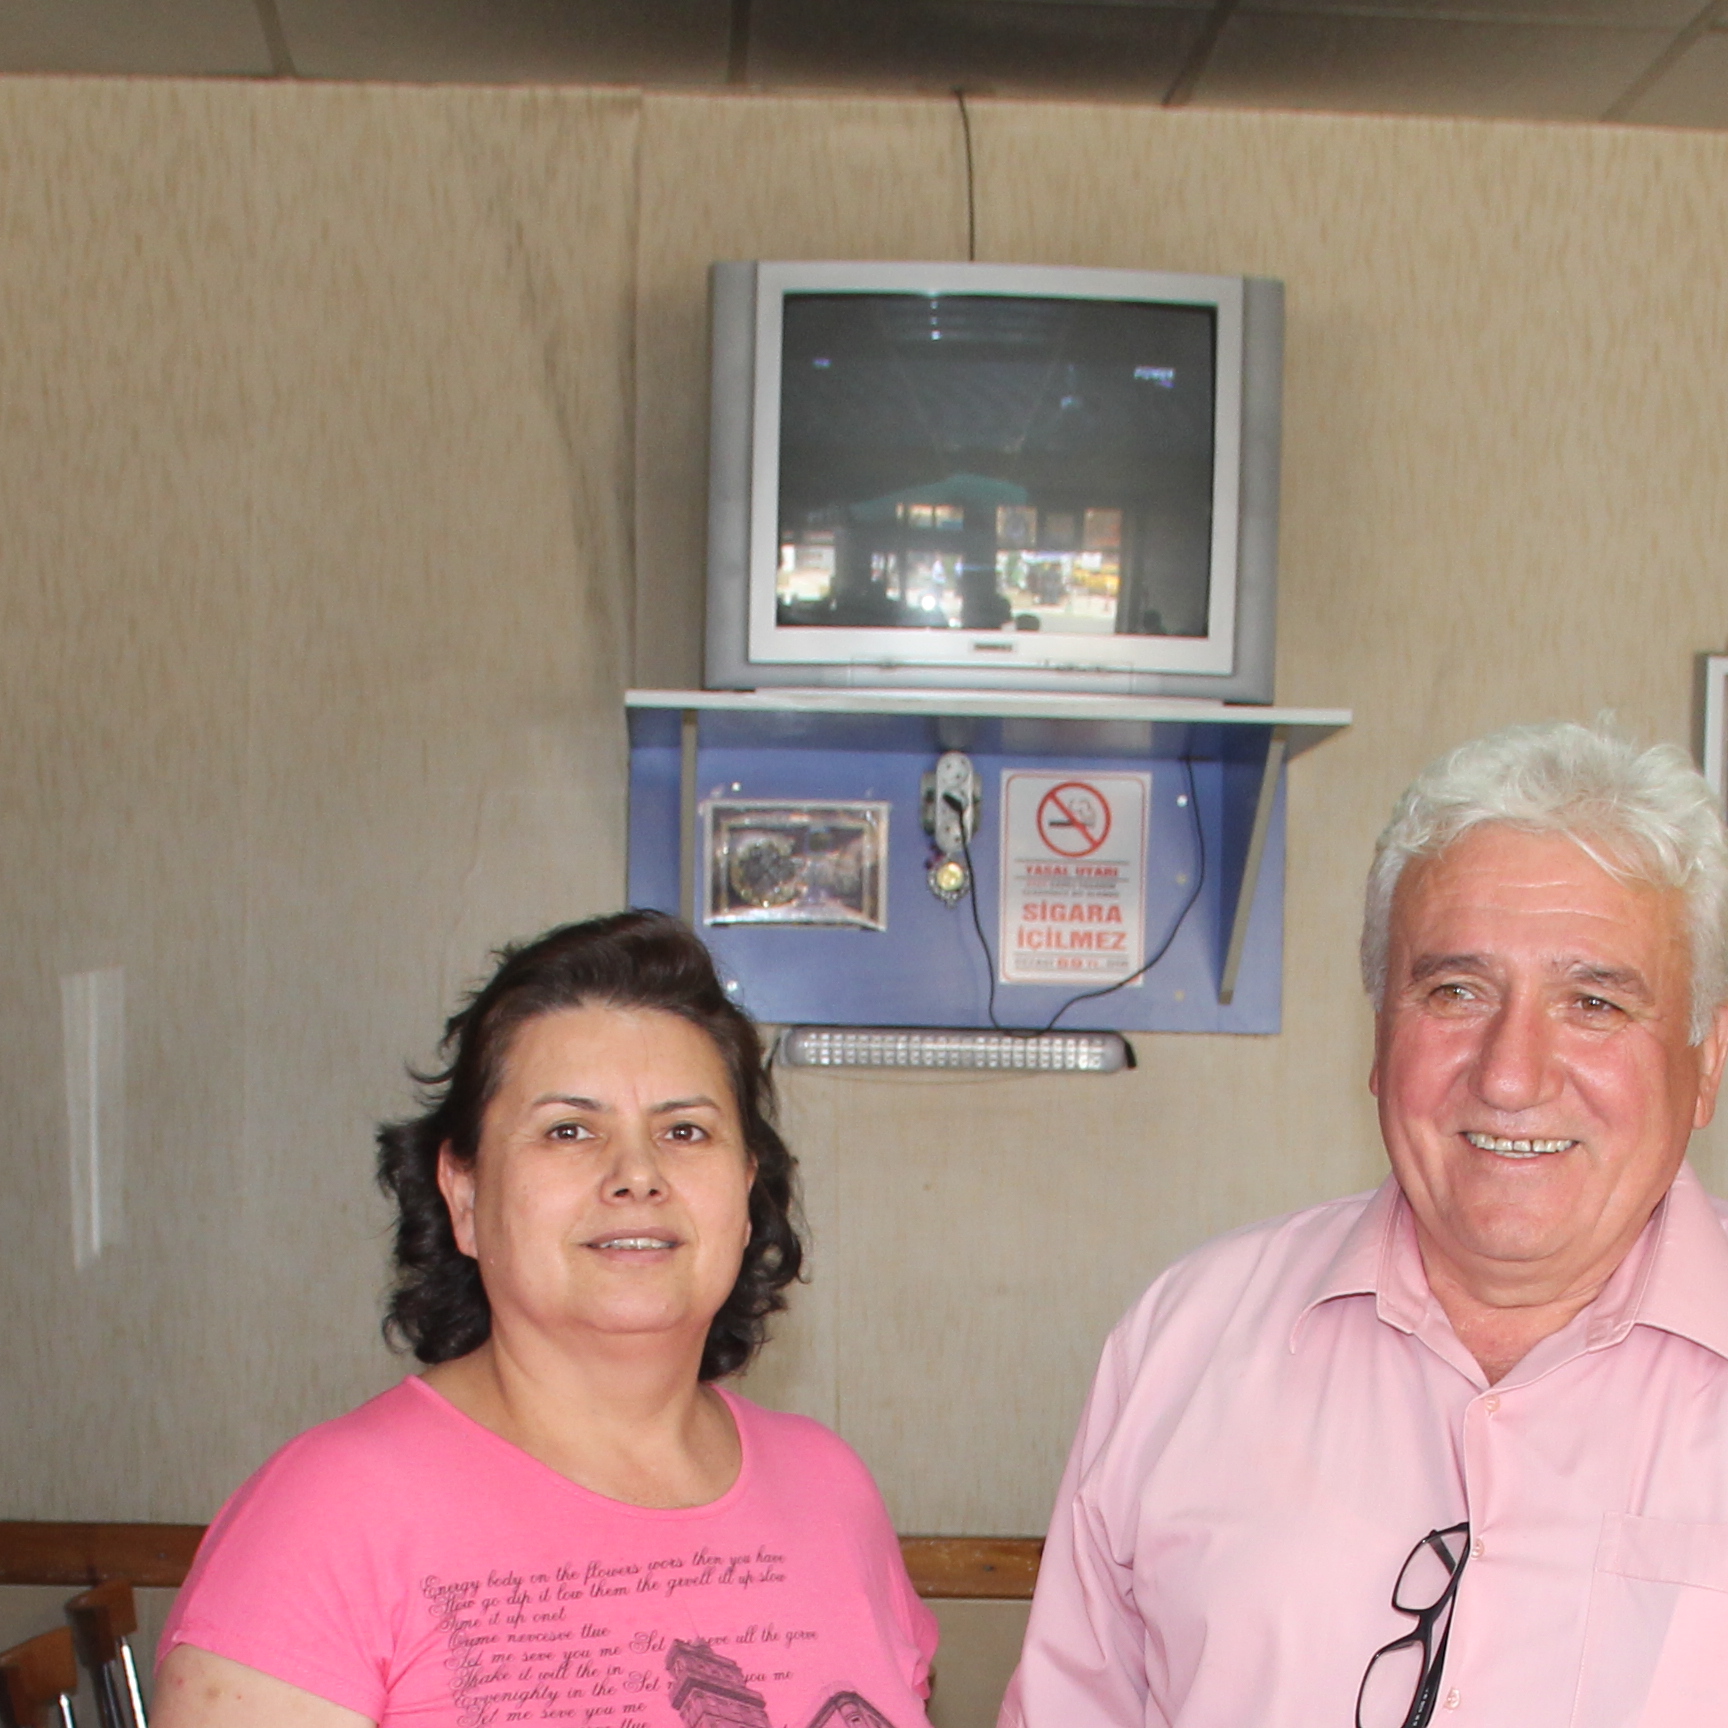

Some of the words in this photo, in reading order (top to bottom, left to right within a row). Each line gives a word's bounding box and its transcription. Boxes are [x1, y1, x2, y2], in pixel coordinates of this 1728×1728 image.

[1026, 865, 1068, 876] YASAL
[1076, 866, 1118, 877] UYARI
[1023, 899, 1122, 922] SİGARA
[1017, 924, 1127, 951] İÇİLMEZ
[421, 1575, 481, 1599] Energy
[487, 1569, 524, 1593] body
[530, 1573, 550, 1584] on
[556, 1562, 579, 1580] the
[729, 1555, 751, 1573] you
[481, 1598, 499, 1614] go
[538, 1587, 551, 1602] it
[557, 1583, 583, 1600] low
[636, 1573, 660, 1592] the
[489, 1611, 501, 1626] it
[491, 1652, 514, 1663] me
[563, 1648, 591, 1668] you
[599, 1645, 621, 1656] me
[761, 1623, 779, 1642] the
[518, 1667, 532, 1681] it
[576, 1659, 600, 1678] the
[607, 1664, 622, 1675] in
[567, 1687, 584, 1698] in
[592, 1678, 617, 1697] the
[506, 1709, 532, 1721] me
[585, 1706, 615, 1723] you
[623, 1702, 647, 1714] me
